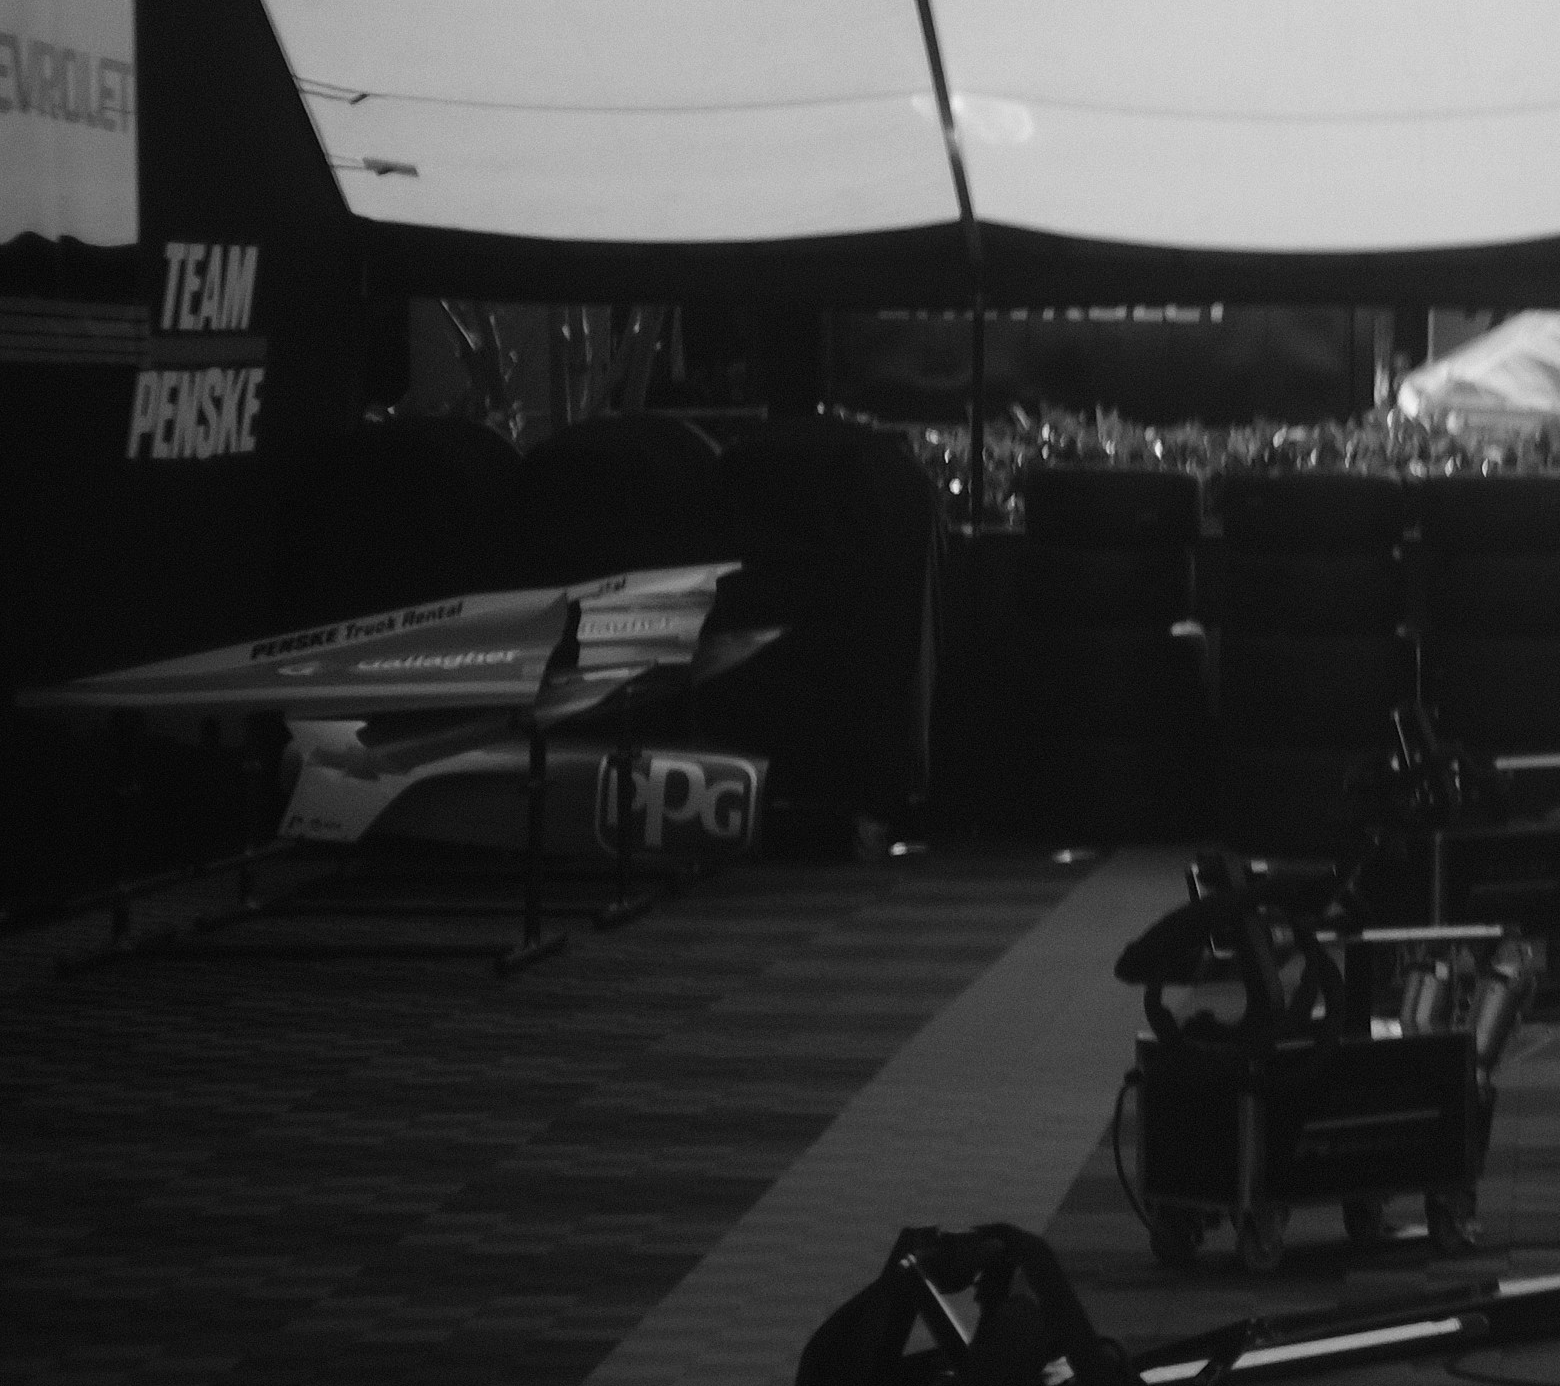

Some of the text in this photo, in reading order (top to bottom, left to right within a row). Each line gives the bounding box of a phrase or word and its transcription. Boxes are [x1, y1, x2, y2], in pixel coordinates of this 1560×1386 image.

[160, 240, 260, 332] TEAM
[126, 367, 266, 461] PENSKE
[251, 600, 464, 660] PENSKE Truck Rental
[606, 758, 745, 847] PPG
